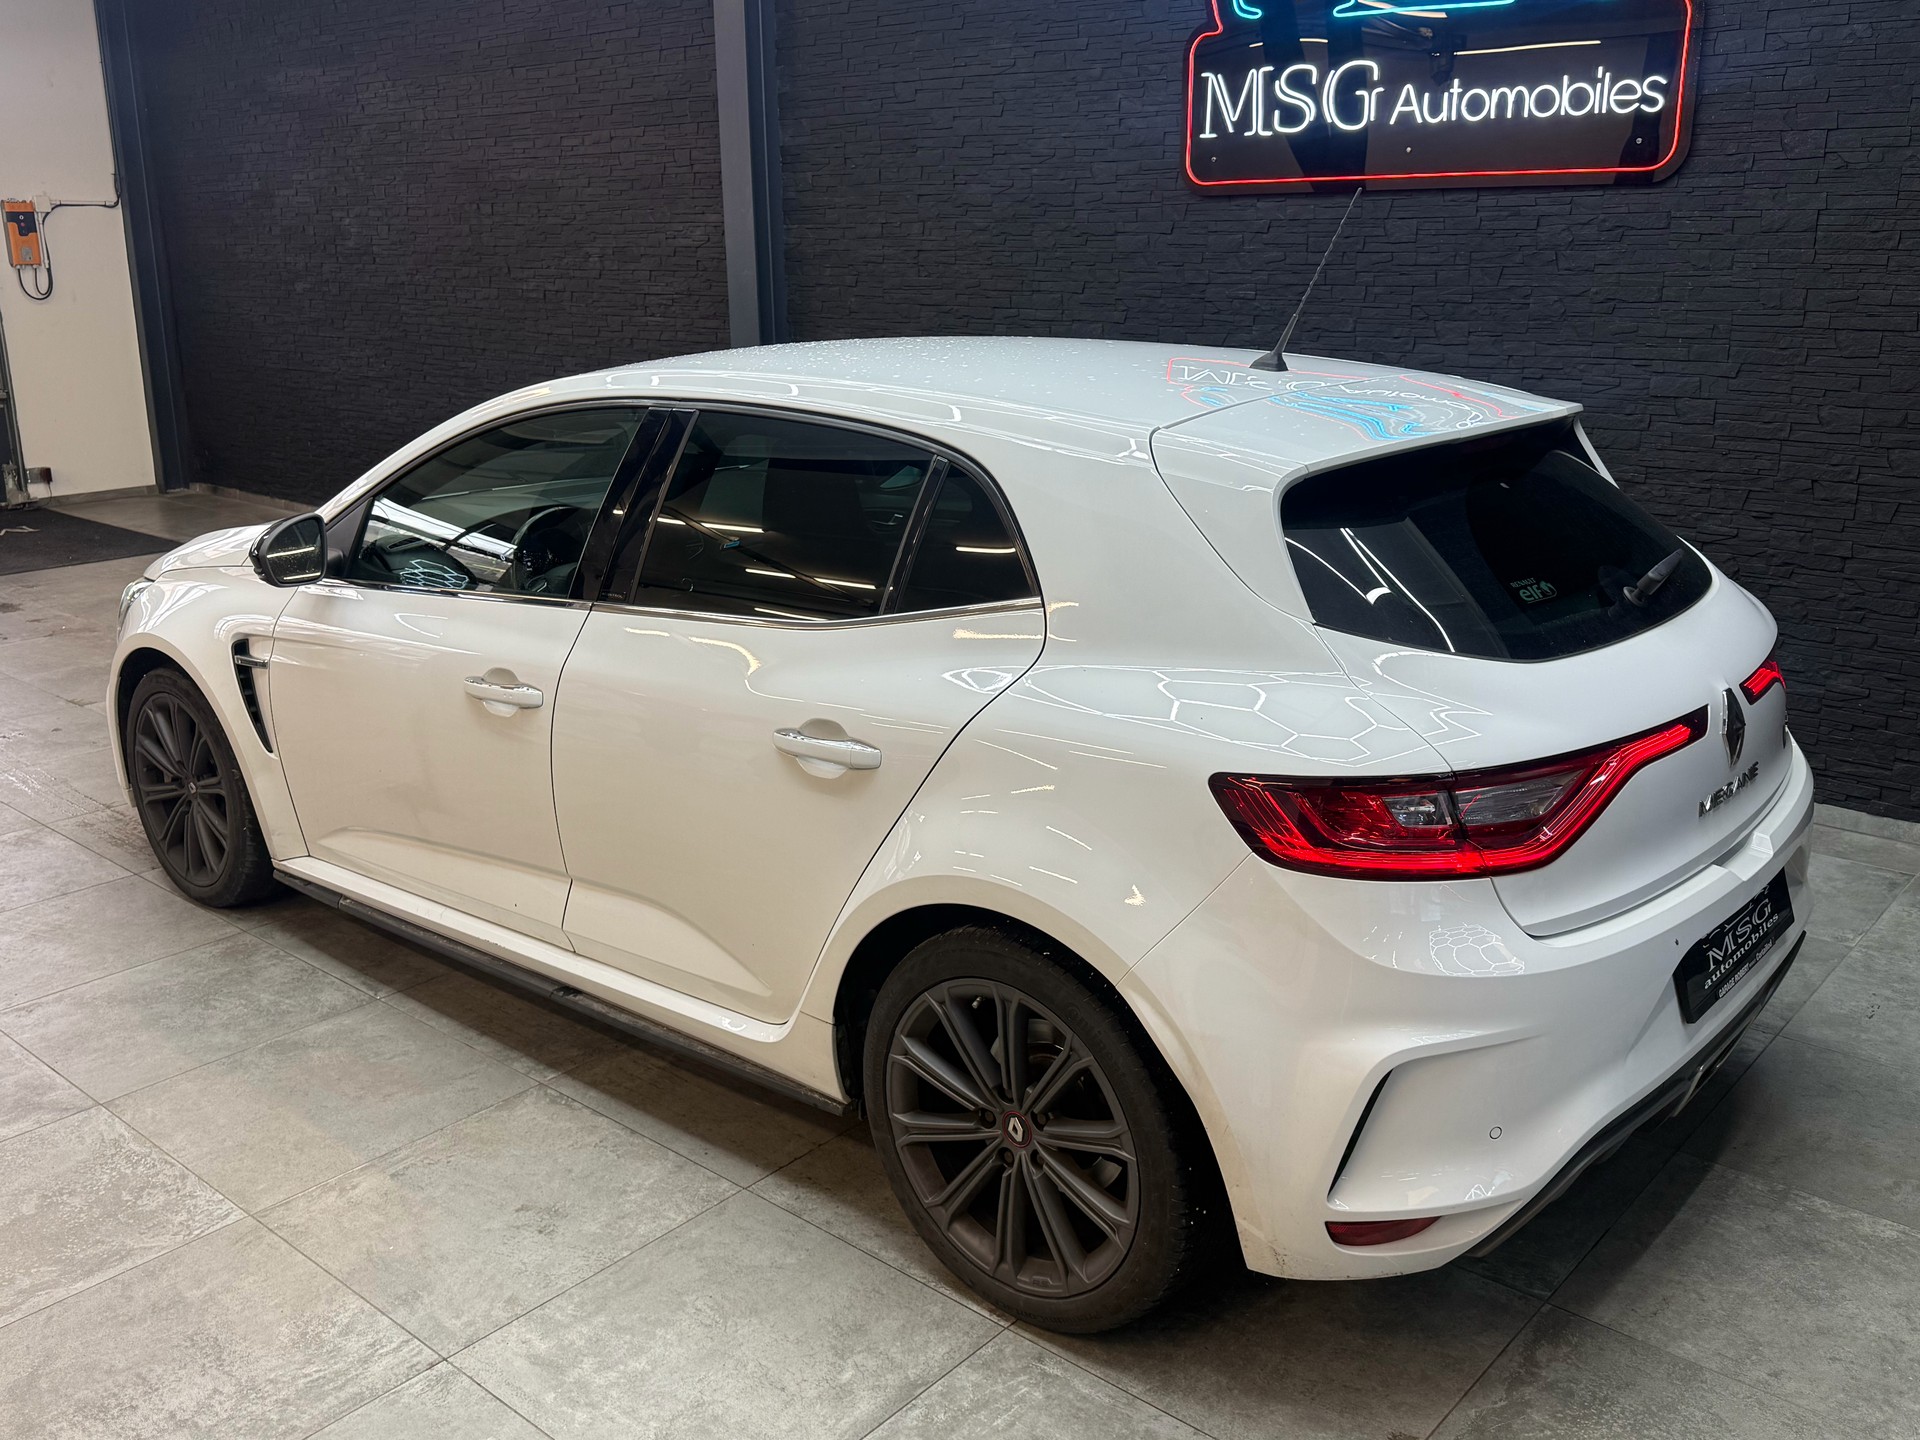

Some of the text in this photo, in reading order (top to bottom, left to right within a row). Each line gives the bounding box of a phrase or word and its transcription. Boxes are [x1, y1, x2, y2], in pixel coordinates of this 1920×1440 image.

[1200, 60, 1668, 138] MSG Automobiles
[1519, 584, 1543, 601] elf
[1698, 761, 1759, 817] MEGANE
[1704, 913, 1779, 990] automobiles
[1706, 898, 1772, 973] MSG
